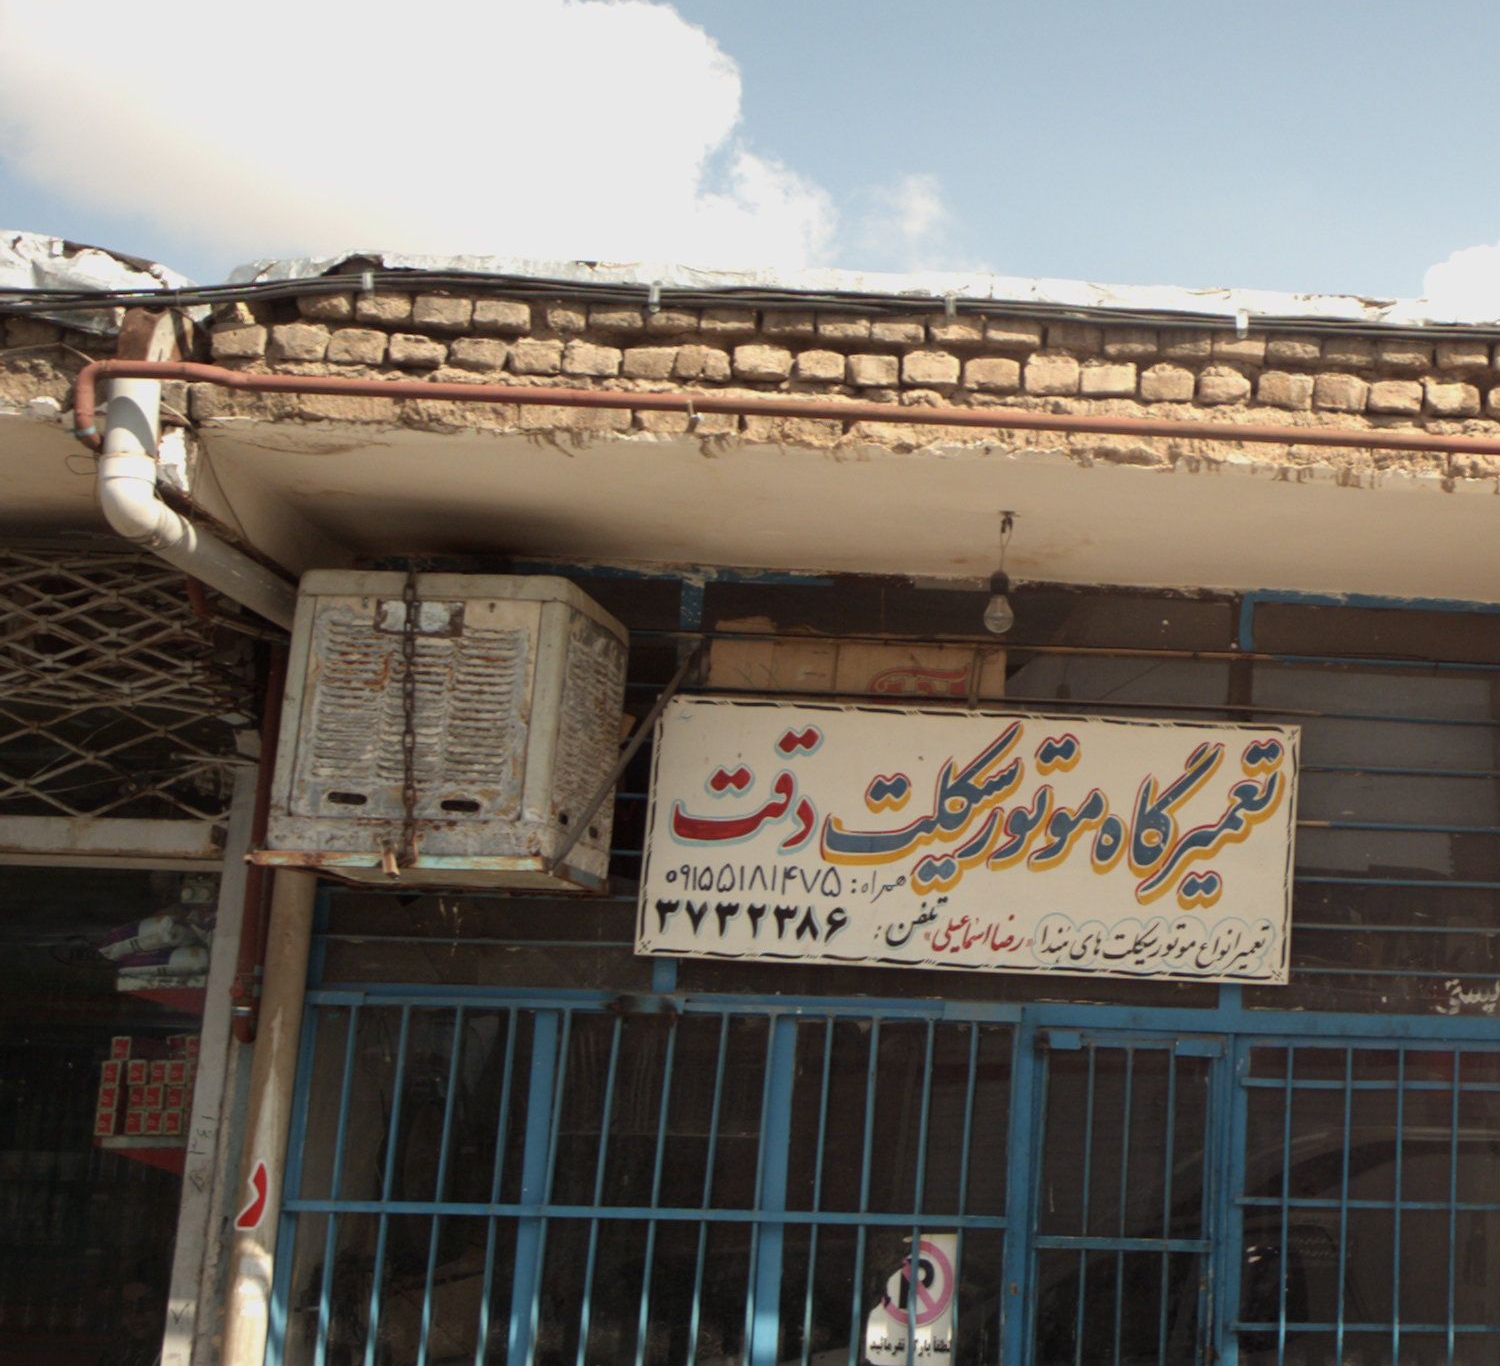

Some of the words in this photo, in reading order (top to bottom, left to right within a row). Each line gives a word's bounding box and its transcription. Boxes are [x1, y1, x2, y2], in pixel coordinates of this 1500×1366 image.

[669, 723, 824, 856] دقت
[820, 720, 1108, 896] موتورسیکلت
[1091, 739, 1285, 909] تعمیرگاه
[665, 863, 842, 897] ۰۹۱۵۵۱۸۱۴۷۵
[655, 898, 848, 944] ۳۷۳۲۳۸۶
[1195, 928, 1242, 969] انواع
[1222, 924, 1270, 971] تعمیر
